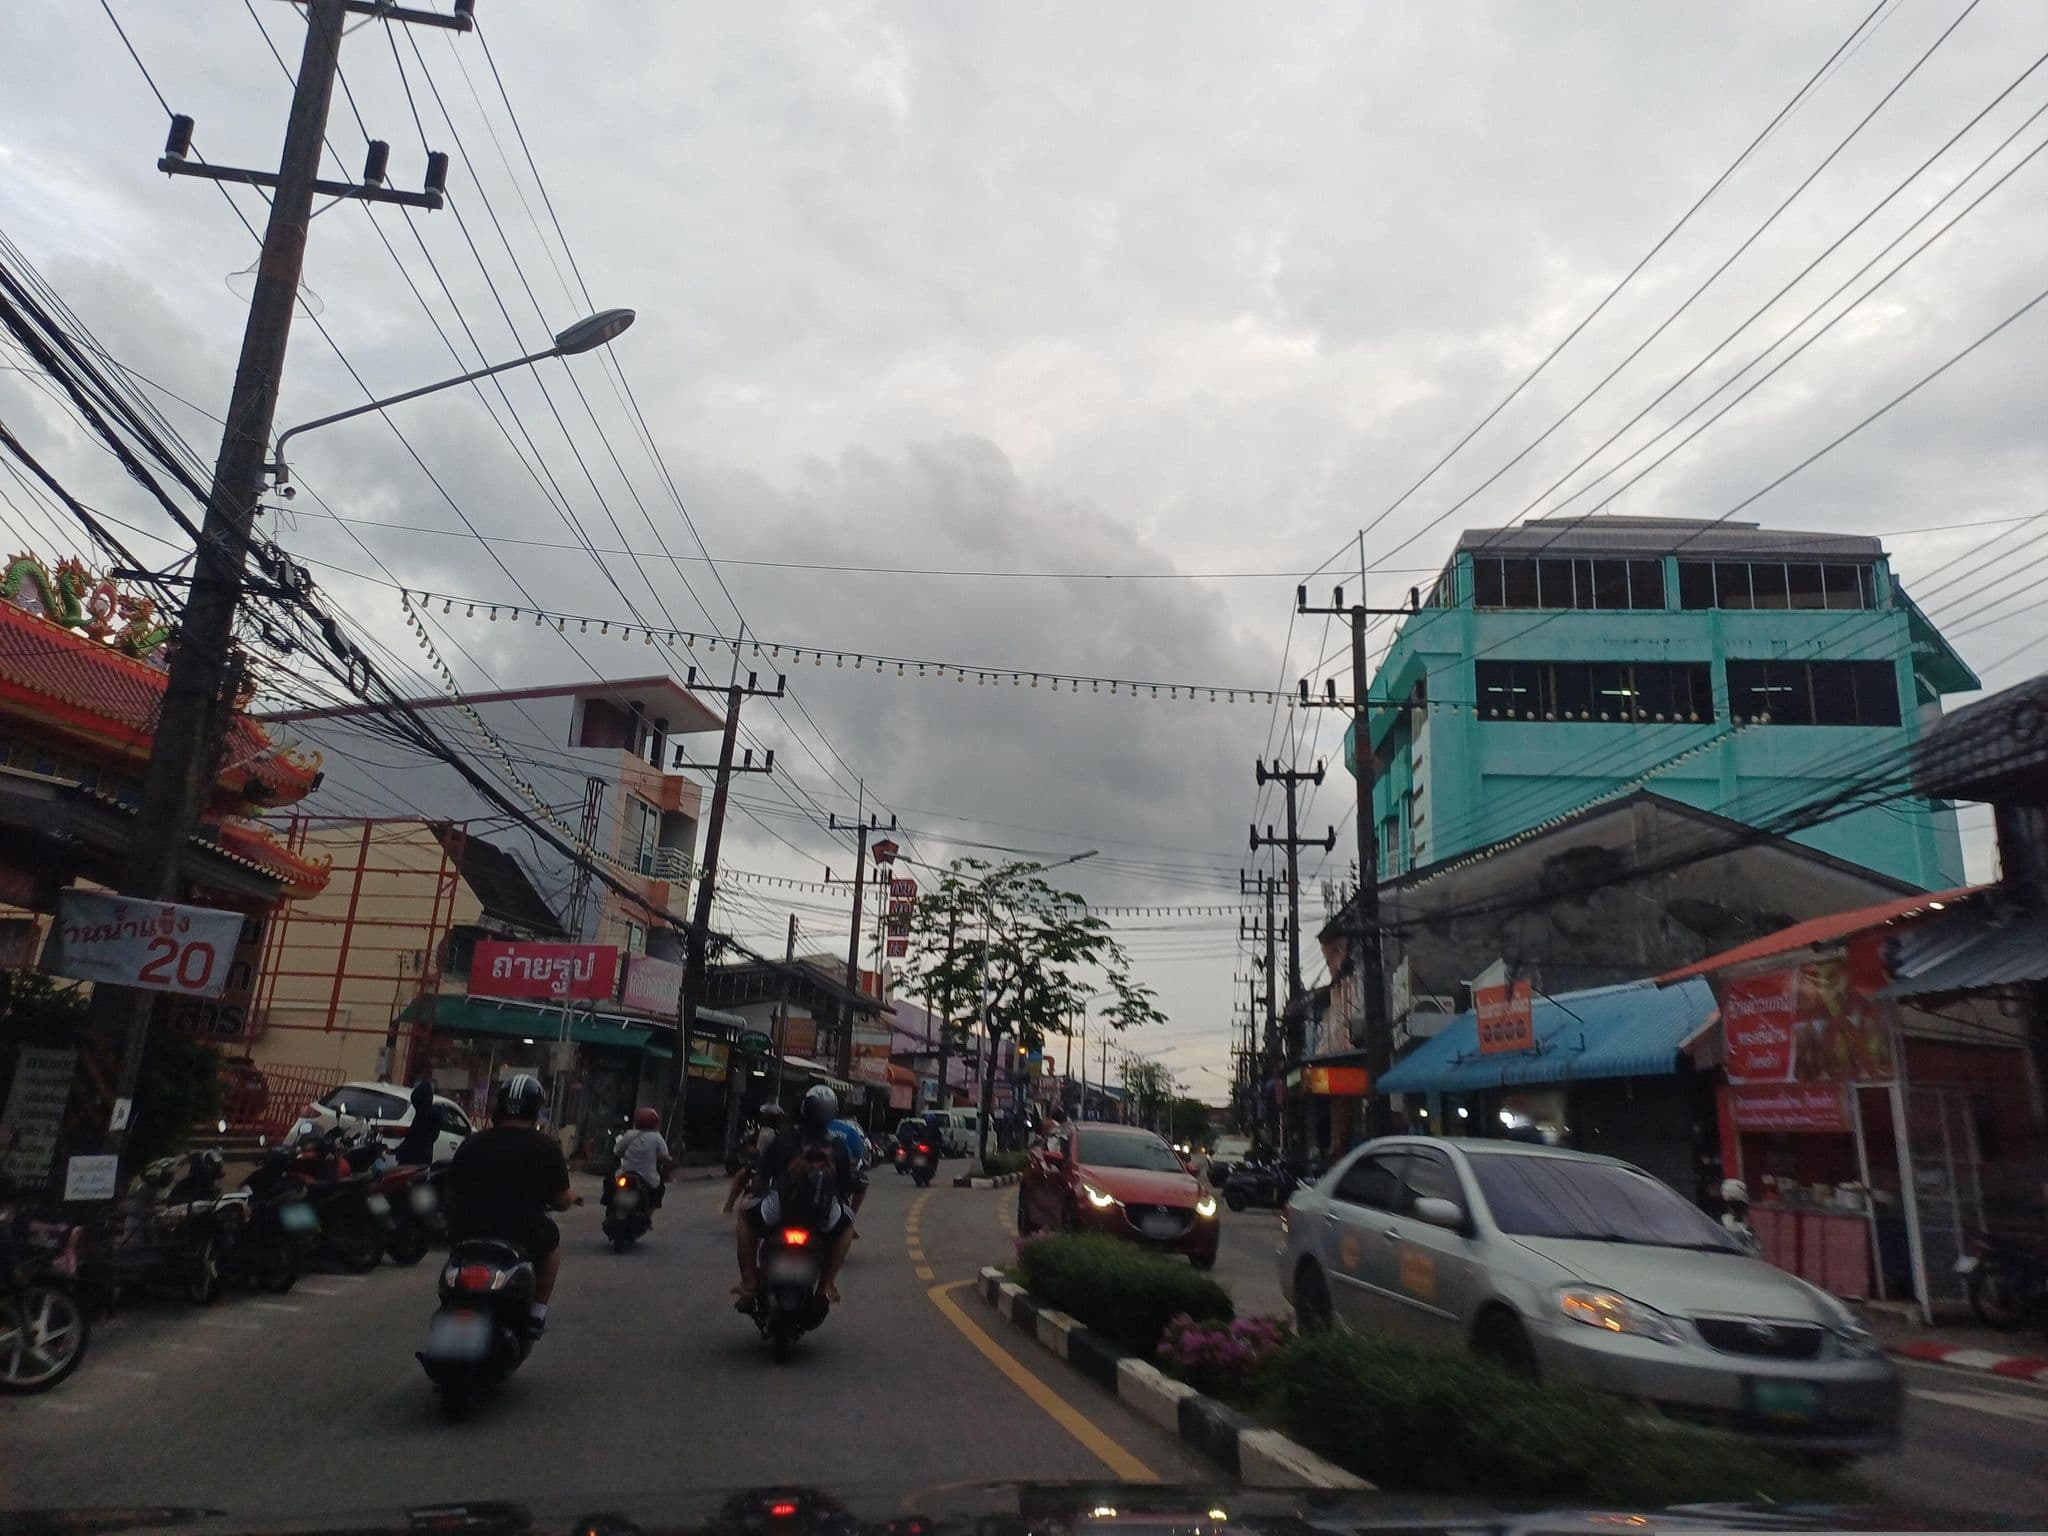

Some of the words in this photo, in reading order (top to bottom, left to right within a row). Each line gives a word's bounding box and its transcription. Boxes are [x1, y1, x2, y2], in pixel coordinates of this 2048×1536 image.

[138, 935, 216, 990] 20
[492, 946, 596, 993] ถ่ายรูป
